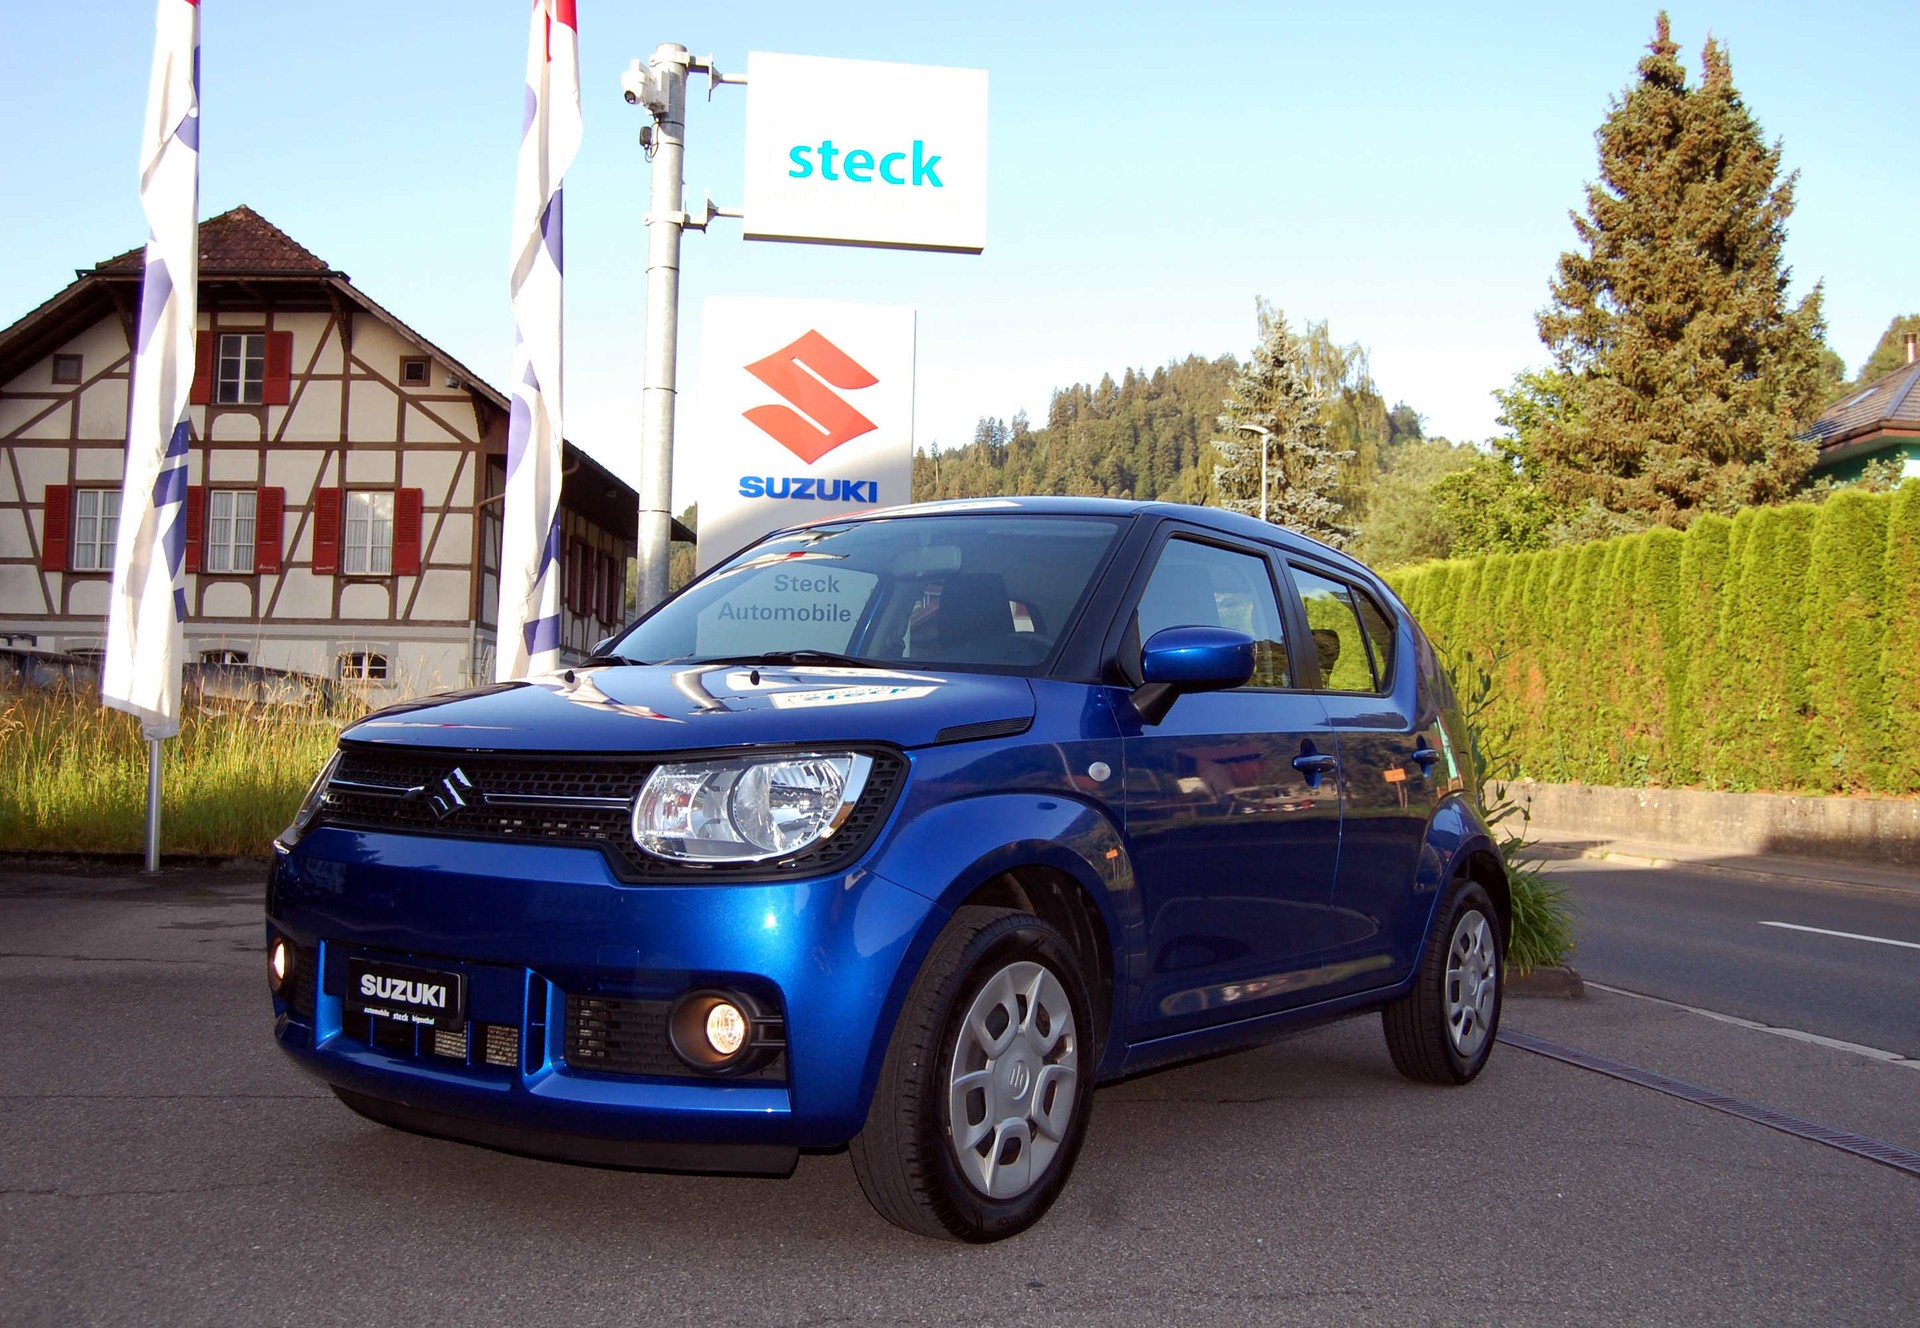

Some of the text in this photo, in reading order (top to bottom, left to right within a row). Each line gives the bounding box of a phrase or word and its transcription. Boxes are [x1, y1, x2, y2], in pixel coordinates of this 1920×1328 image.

[789, 139, 944, 188] steck
[739, 476, 878, 503] SUZUKI
[774, 574, 840, 593] Steck
[718, 602, 852, 622] Automobile
[360, 974, 446, 1008] SUZUKI
